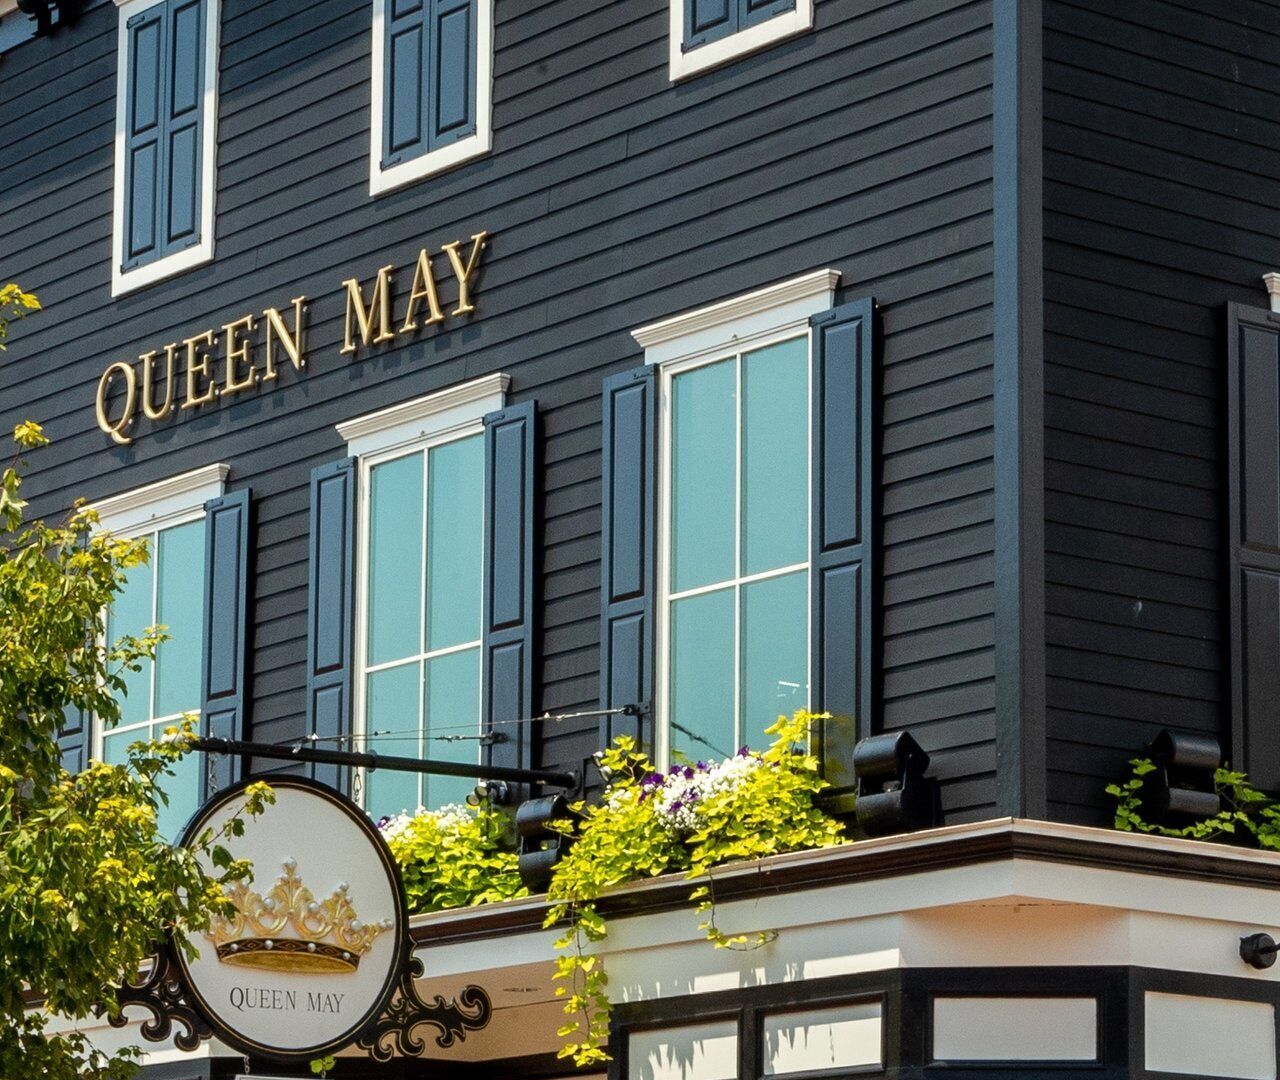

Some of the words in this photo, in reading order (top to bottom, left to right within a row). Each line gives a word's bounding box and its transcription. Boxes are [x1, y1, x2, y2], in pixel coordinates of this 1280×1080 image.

[95, 295, 308, 444] QUEEN
[339, 230, 488, 356] MAY
[229, 986, 297, 1012] QUEEN
[307, 992, 344, 1013] MAY
